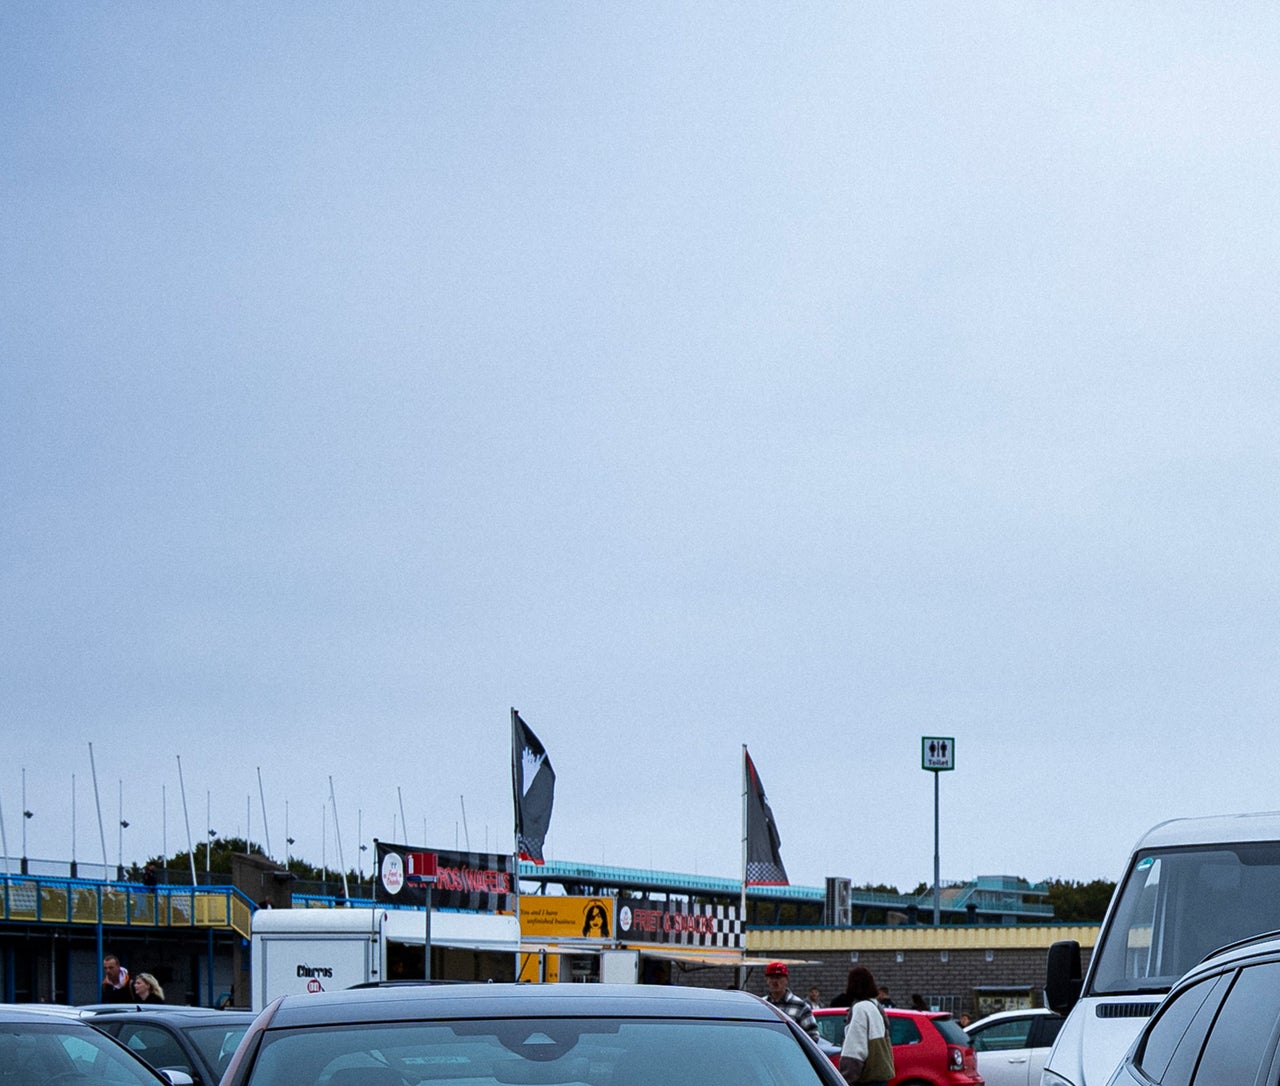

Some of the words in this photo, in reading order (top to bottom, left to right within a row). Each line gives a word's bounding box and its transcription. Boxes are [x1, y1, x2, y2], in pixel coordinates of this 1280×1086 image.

[928, 759, 949, 767] Toilet
[632, 907, 663, 934] FRIET
[673, 912, 715, 936] SNACKS
